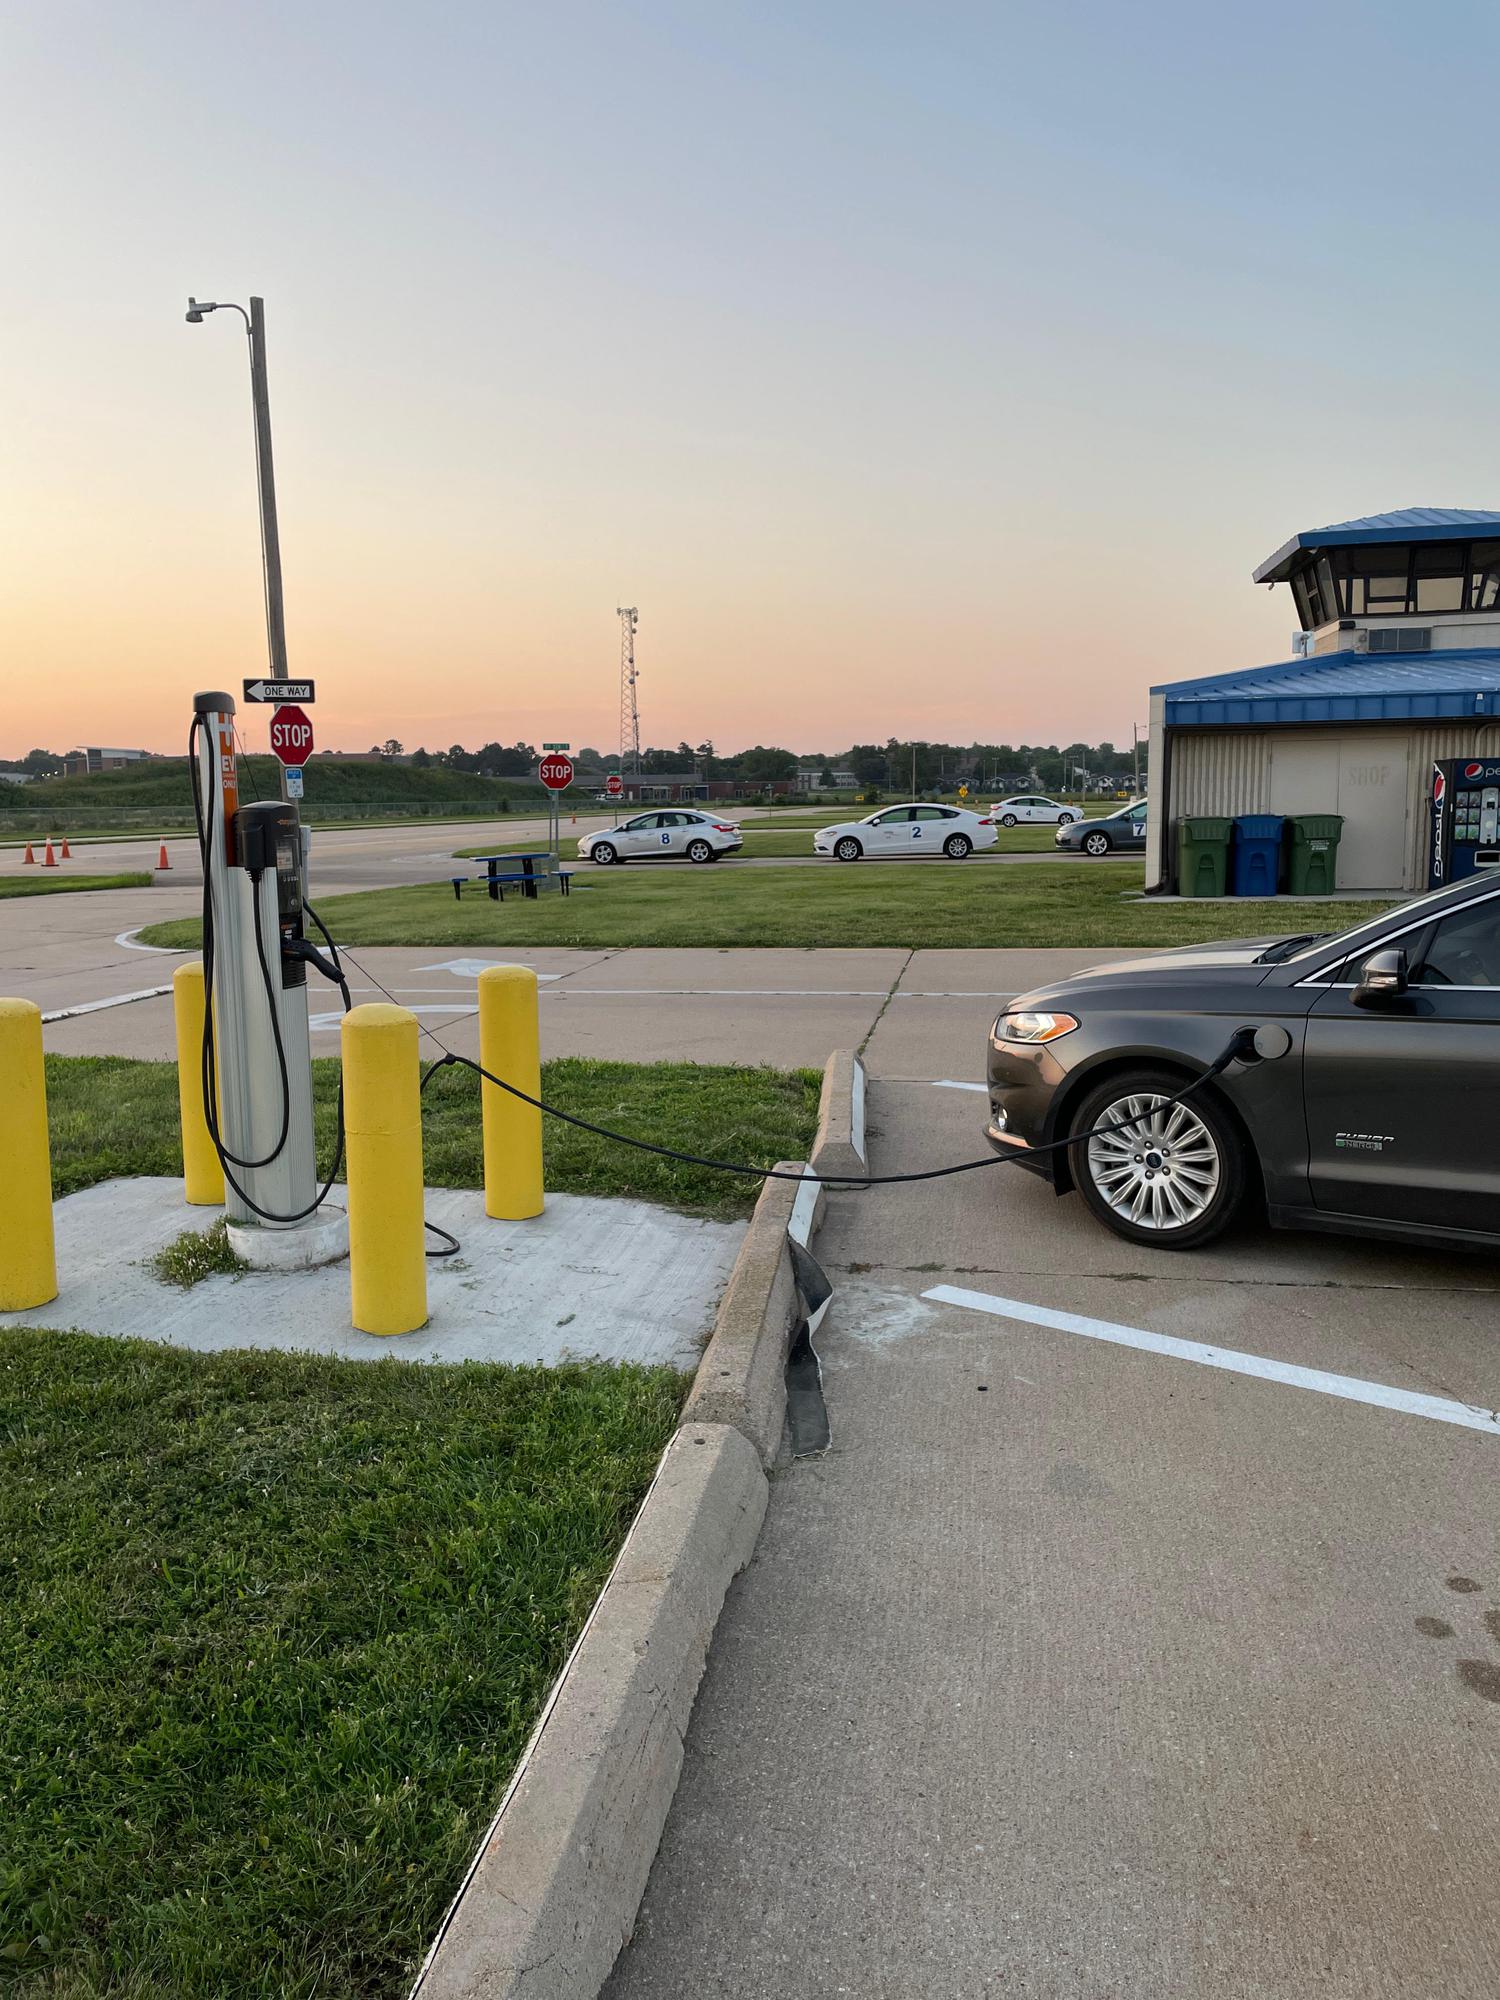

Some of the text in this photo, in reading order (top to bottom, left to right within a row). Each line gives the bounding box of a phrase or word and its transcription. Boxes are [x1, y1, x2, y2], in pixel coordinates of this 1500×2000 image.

[264, 686, 307, 696] ONE WAY
[273, 723, 310, 747] STOP
[222, 755, 235, 771] EV
[541, 765, 571, 779] STOP
[1349, 765, 1391, 787] SHOP
[223, 780, 236, 789] ONL
[608, 781, 622, 789] STOP
[911, 826, 922, 839] 2
[1134, 823, 1145, 836] 7
[661, 832, 670, 845] 8
